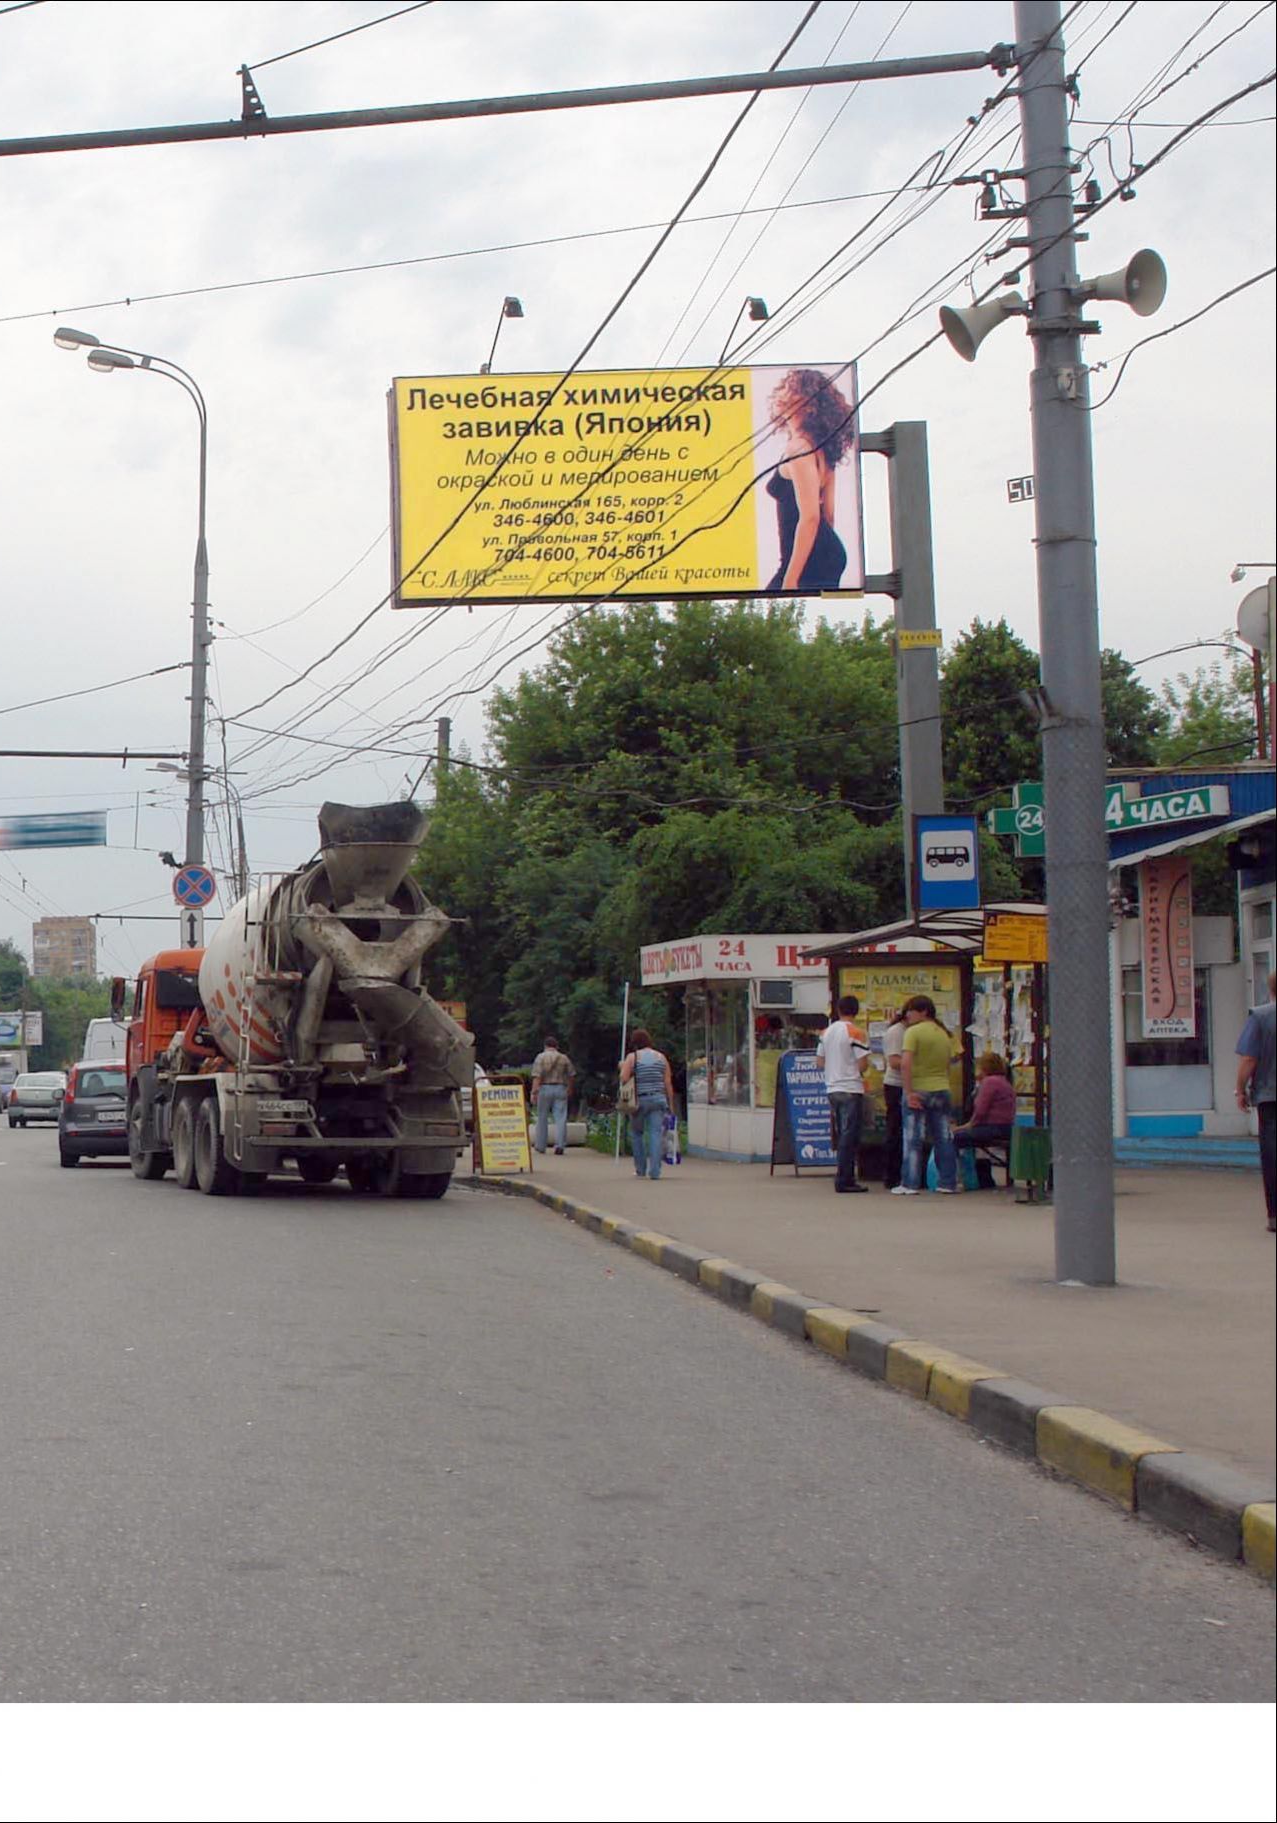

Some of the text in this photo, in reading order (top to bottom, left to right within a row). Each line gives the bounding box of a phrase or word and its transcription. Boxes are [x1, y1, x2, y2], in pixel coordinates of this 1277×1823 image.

[406, 383, 745, 410] Лечебная химическая
[442, 408, 712, 441] завивка (Япония)
[465, 444, 690, 466] Можно в один день с
[437, 468, 534, 492] окраской
[540, 473, 553, 486] и
[474, 501, 495, 513] ул.
[499, 497, 591, 510] Люблинская
[597, 495, 626, 509] 165,
[674, 493, 684, 506] 2
[493, 510, 665, 528] 346-4600, 346-4601
[482, 537, 502, 548] ул.
[508, 532, 598, 546] Привольная
[627, 532, 664, 544] корп.
[671, 529, 677, 541] 1
[547, 569, 606, 588] секрет
[611, 566, 668, 582] Вашей
[674, 566, 751, 585] красоты
[1130, 794, 1206, 822] ЧАСА
[1020, 812, 1044, 828] 24
[719, 940, 746, 956] 24
[714, 961, 753, 972] ЧАСА
[871, 974, 931, 986] АДАМАС
[791, 1061, 818, 1071] Люб
[481, 1088, 520, 1101] РЕМОНТ
